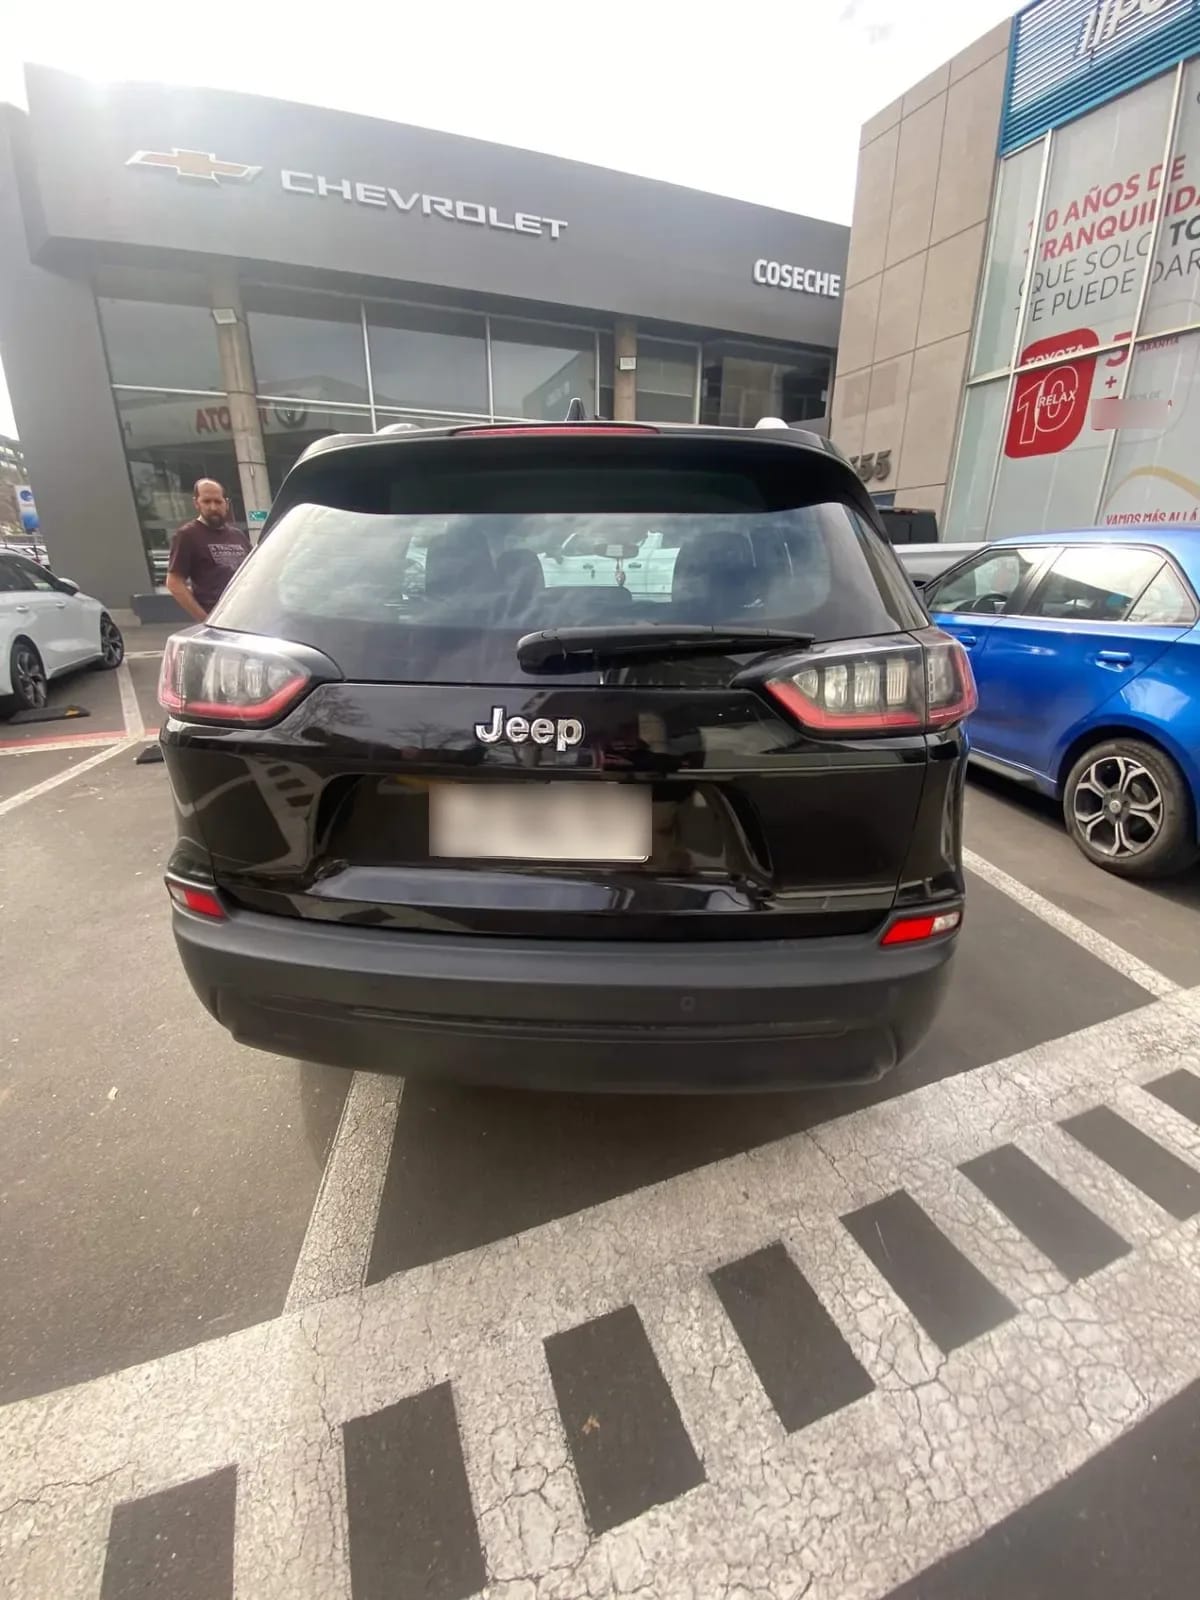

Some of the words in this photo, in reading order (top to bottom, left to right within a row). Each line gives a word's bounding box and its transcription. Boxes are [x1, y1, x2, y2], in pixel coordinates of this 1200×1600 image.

[281, 170, 568, 239] CHEVROLET
[1063, 173, 1140, 226] AÑOS
[754, 259, 841, 297] COSECHE
[1052, 268, 1136, 316] PUEDE
[1038, 390, 1076, 407] RELAX
[1106, 512, 1141, 525] VAMOS
[475, 707, 583, 752] Jeep
